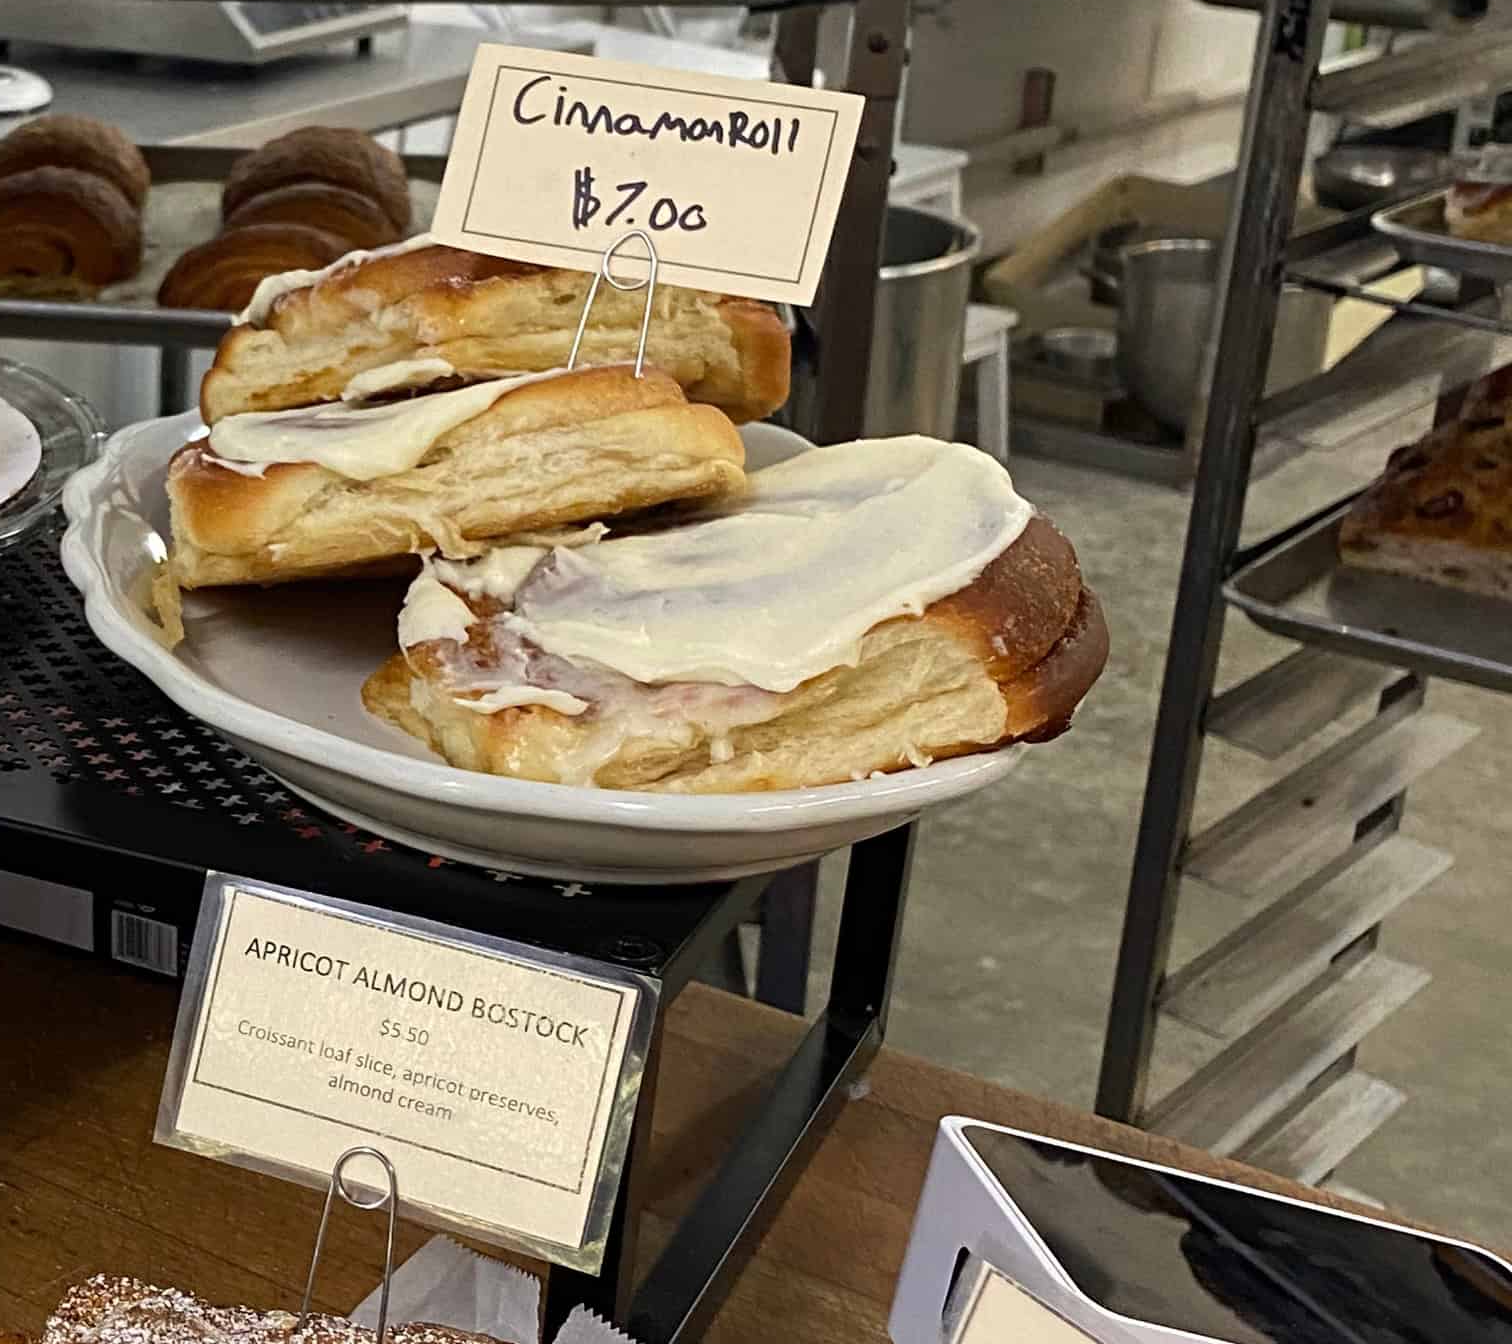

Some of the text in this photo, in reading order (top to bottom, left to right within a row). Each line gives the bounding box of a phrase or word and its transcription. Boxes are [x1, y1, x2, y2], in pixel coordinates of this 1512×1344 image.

[573, 167, 707, 231] $7.00
[244, 936, 590, 1049] APRICOT ALMOND BOSTOCK
[378, 1019, 430, 1047] $5.50
[237, 1019, 561, 1127] Croissant loaf slice, apricot preserves,
[327, 1072, 454, 1122] almond cream
